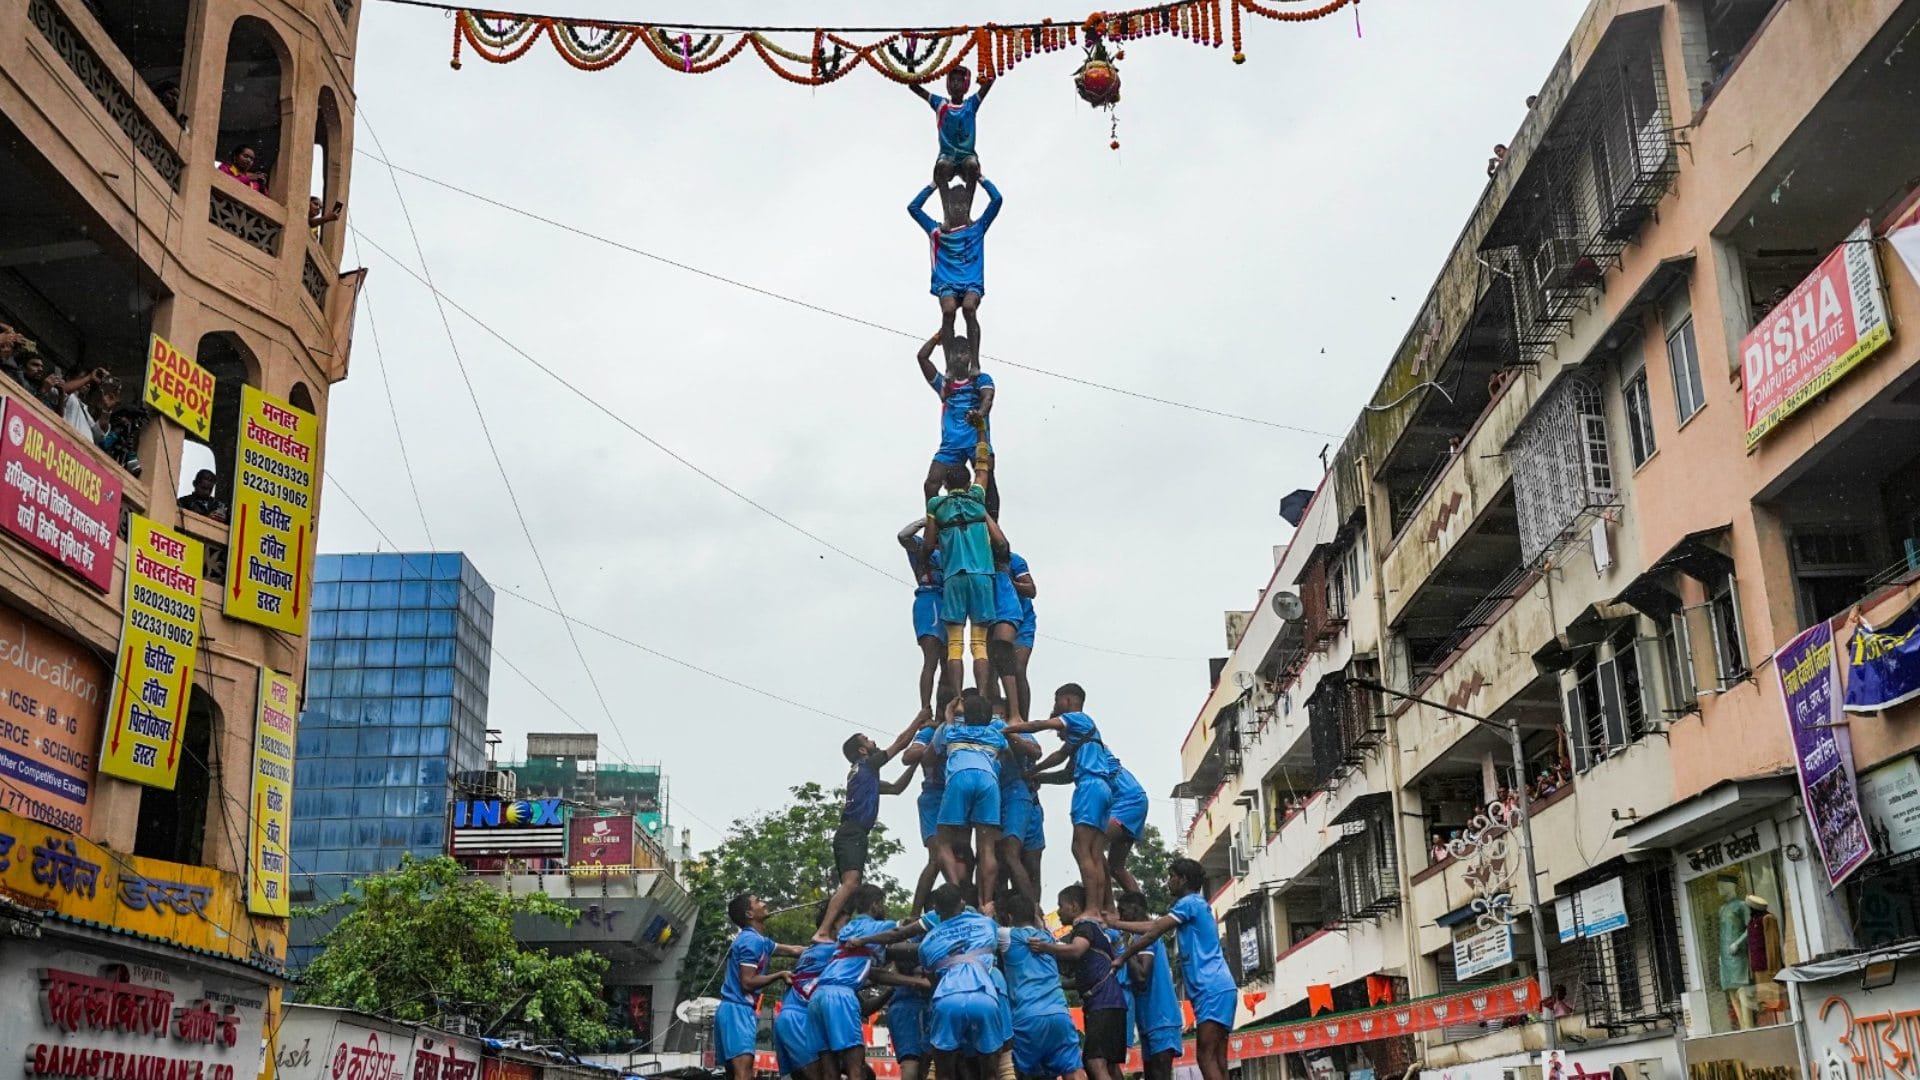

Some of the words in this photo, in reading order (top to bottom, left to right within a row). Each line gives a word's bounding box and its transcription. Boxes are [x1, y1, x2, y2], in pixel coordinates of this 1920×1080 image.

[1746, 275, 1843, 390] DiSHA
[154, 339, 213, 397] DADAR
[1748, 357, 1798, 411] COMPUTER
[1800, 317, 1844, 371] INSTITUTE
[150, 364, 210, 419] XEROX
[261, 400, 300, 432] मनहर
[24, 426, 102, 506] AIR-O-SERVICES
[244, 448, 309, 487] 9820293329
[243, 471, 308, 509] 9223319062
[150, 530, 186, 562] मनहर
[133, 584, 195, 623] 9820293329
[257, 590, 281, 614] डस्टर
[131, 608, 193, 647] 9223319062
[9, 689, 37, 717] ICSE
[46, 704, 57, 726] IB
[65, 715, 78, 735] IG
[41, 738, 89, 773] SCIENCE
[132, 742, 158, 768] डस्टर
[18, 760, 62, 788] Competitive
[62, 778, 87, 797] Exams
[454, 798, 562, 828] INOX
[119, 873, 213, 920] डस्टर
[33, 1044, 189, 1080] SAHASTRAKIRAN
